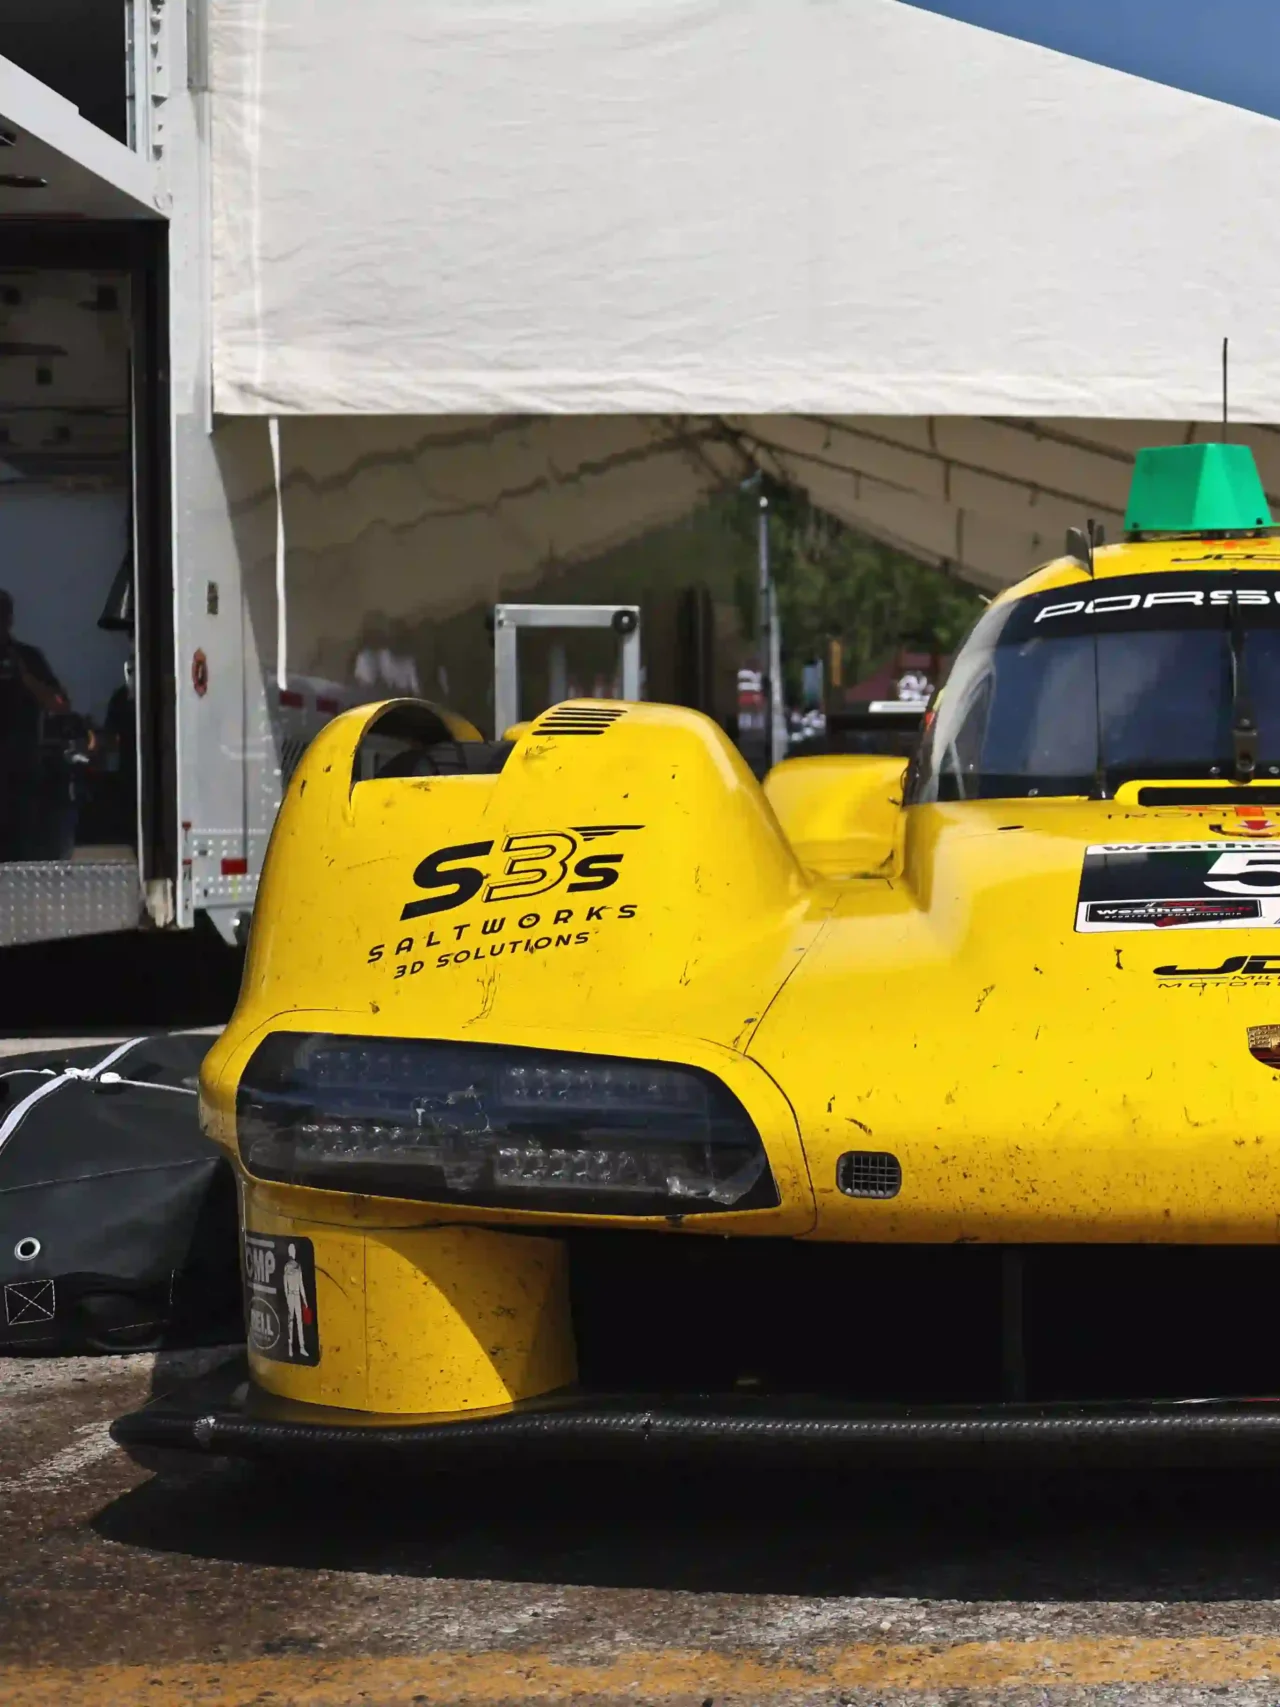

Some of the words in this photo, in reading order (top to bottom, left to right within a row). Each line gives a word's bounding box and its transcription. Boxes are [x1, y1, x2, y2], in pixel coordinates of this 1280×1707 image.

[367, 904, 638, 964] SALTWORKS
[393, 960, 425, 980] 3D
[436, 931, 590, 968] SOLUTIONS
